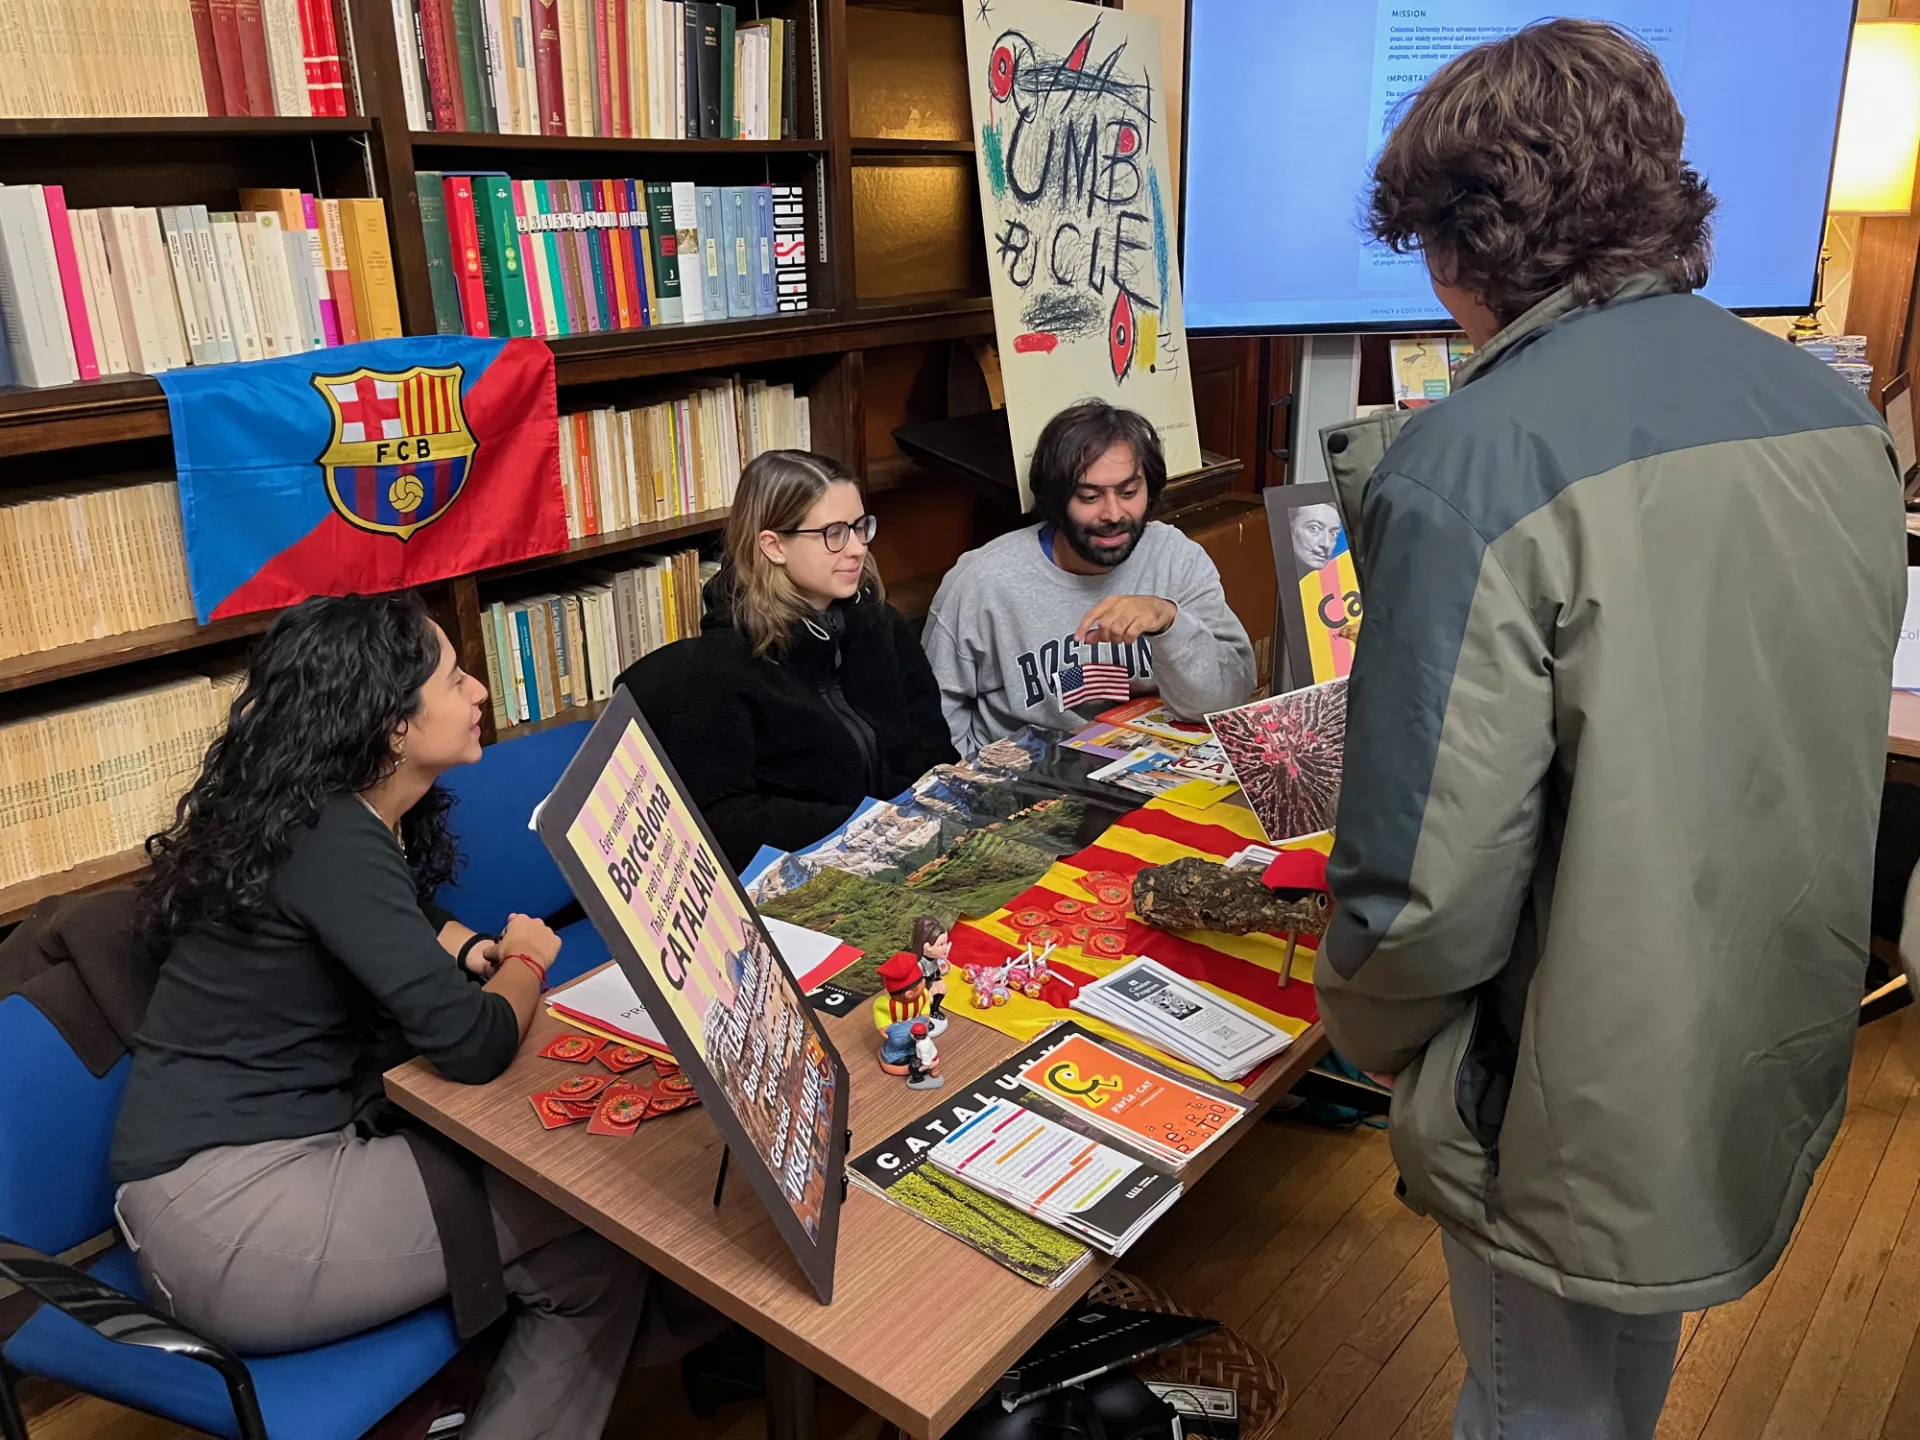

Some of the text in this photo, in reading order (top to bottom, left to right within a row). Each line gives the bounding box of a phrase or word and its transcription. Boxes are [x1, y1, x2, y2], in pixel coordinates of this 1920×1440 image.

[1391, 10, 1427, 18] MISSION
[1415, 26, 1440, 34] University
[518, 218, 525, 230] 2
[531, 216, 539, 228] 3
[543, 215, 550, 228] 4
[555, 215, 562, 227] 5
[565, 214, 572, 226] 6
[576, 215, 583, 228] 7
[588, 213, 594, 226] 8
[599, 213, 605, 225] 9
[376, 438, 431, 463] FCB
[1318, 590, 1363, 629] Ca
[1900, 629, 1920, 640] Col
[599, 831, 615, 855] Ever
[612, 804, 630, 836] wonder
[625, 784, 640, 811] why
[607, 783, 671, 904] Barcelona
[663, 871, 681, 911] because
[660, 842, 719, 990] CATALAN!
[1128, 980, 1152, 993] Catalan
[1134, 983, 1160, 998] Program
[728, 1008, 751, 1060] LEARN
[742, 953, 757, 996] NOW!
[742, 1067, 760, 1102] Bon
[794, 1118, 810, 1147] EL
[787, 1136, 810, 1202] VISCA
